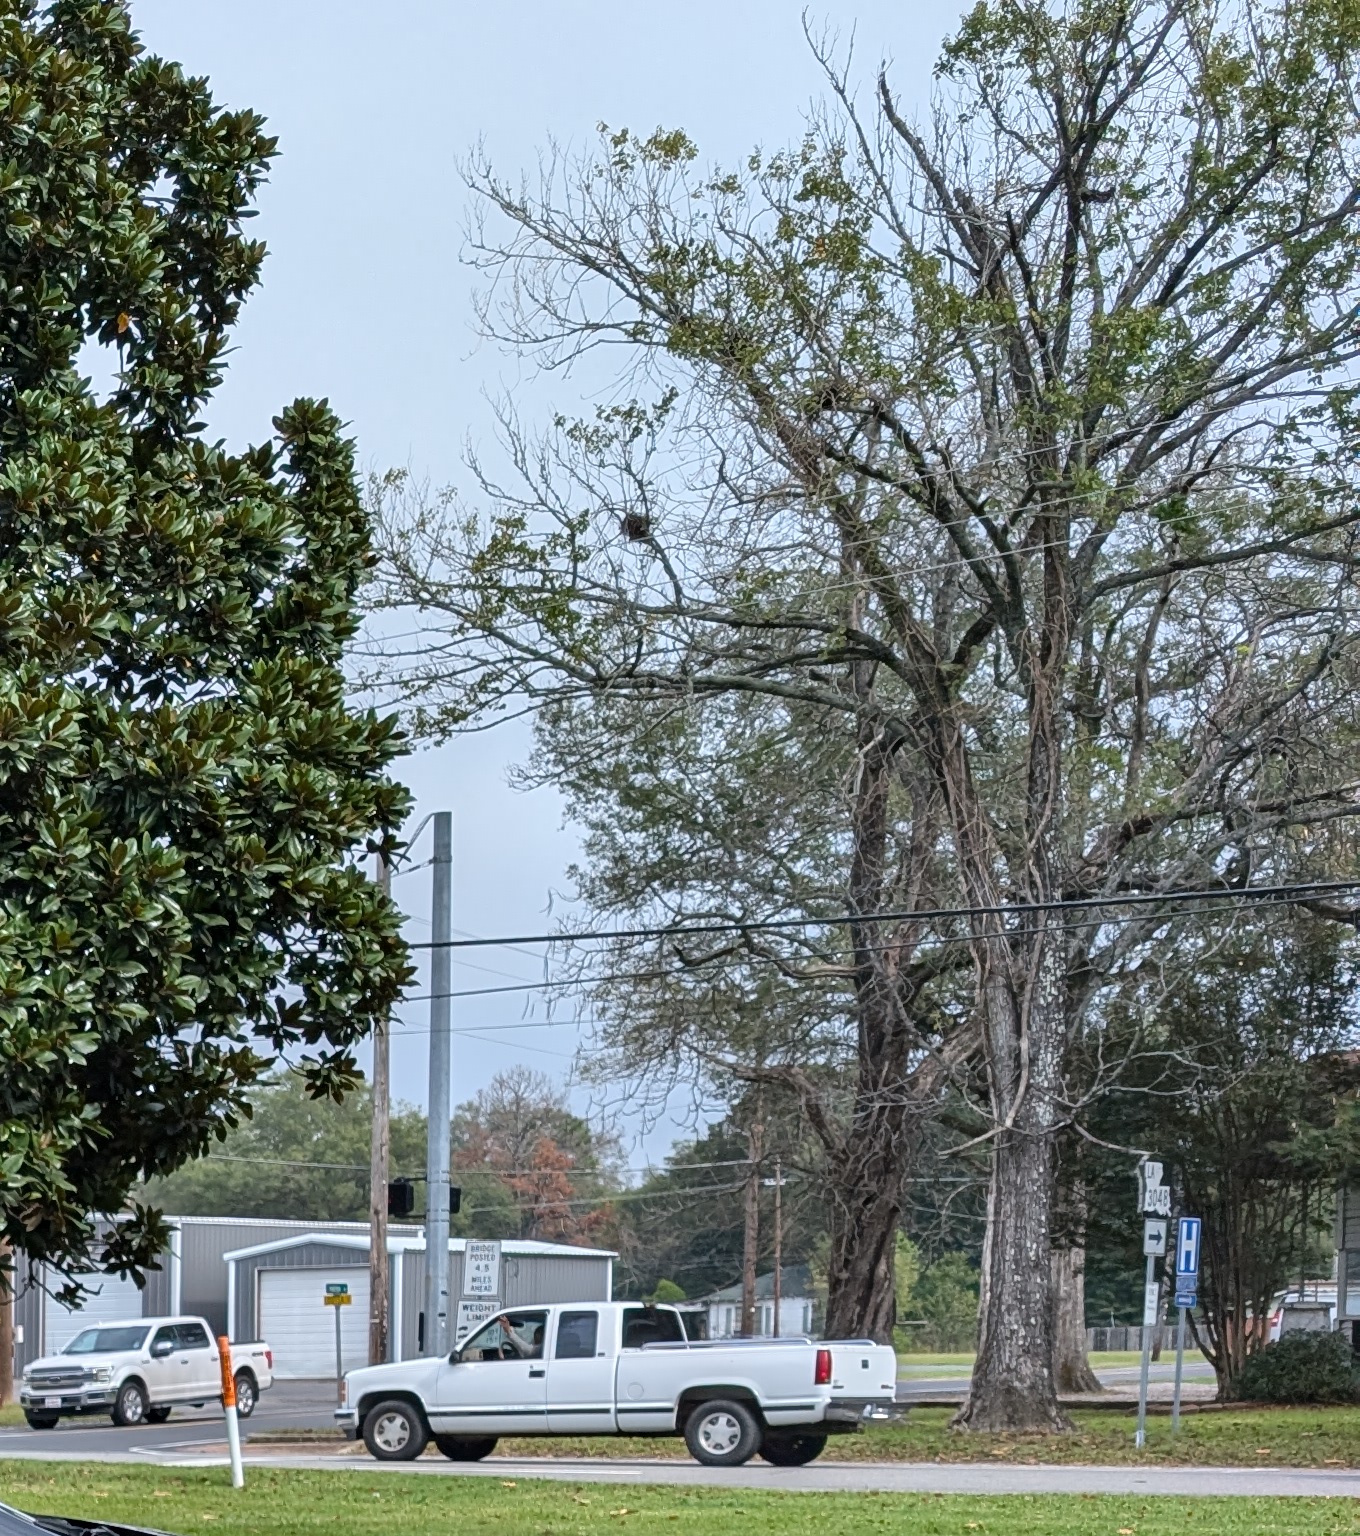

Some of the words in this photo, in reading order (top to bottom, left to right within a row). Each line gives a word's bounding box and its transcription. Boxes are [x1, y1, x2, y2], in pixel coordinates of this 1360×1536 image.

[1148, 1188, 1169, 1208] 3048
[1180, 1221, 1198, 1271] H
[462, 1303, 497, 1313] WEIGHT
[466, 1313, 490, 1321] LIMIT
